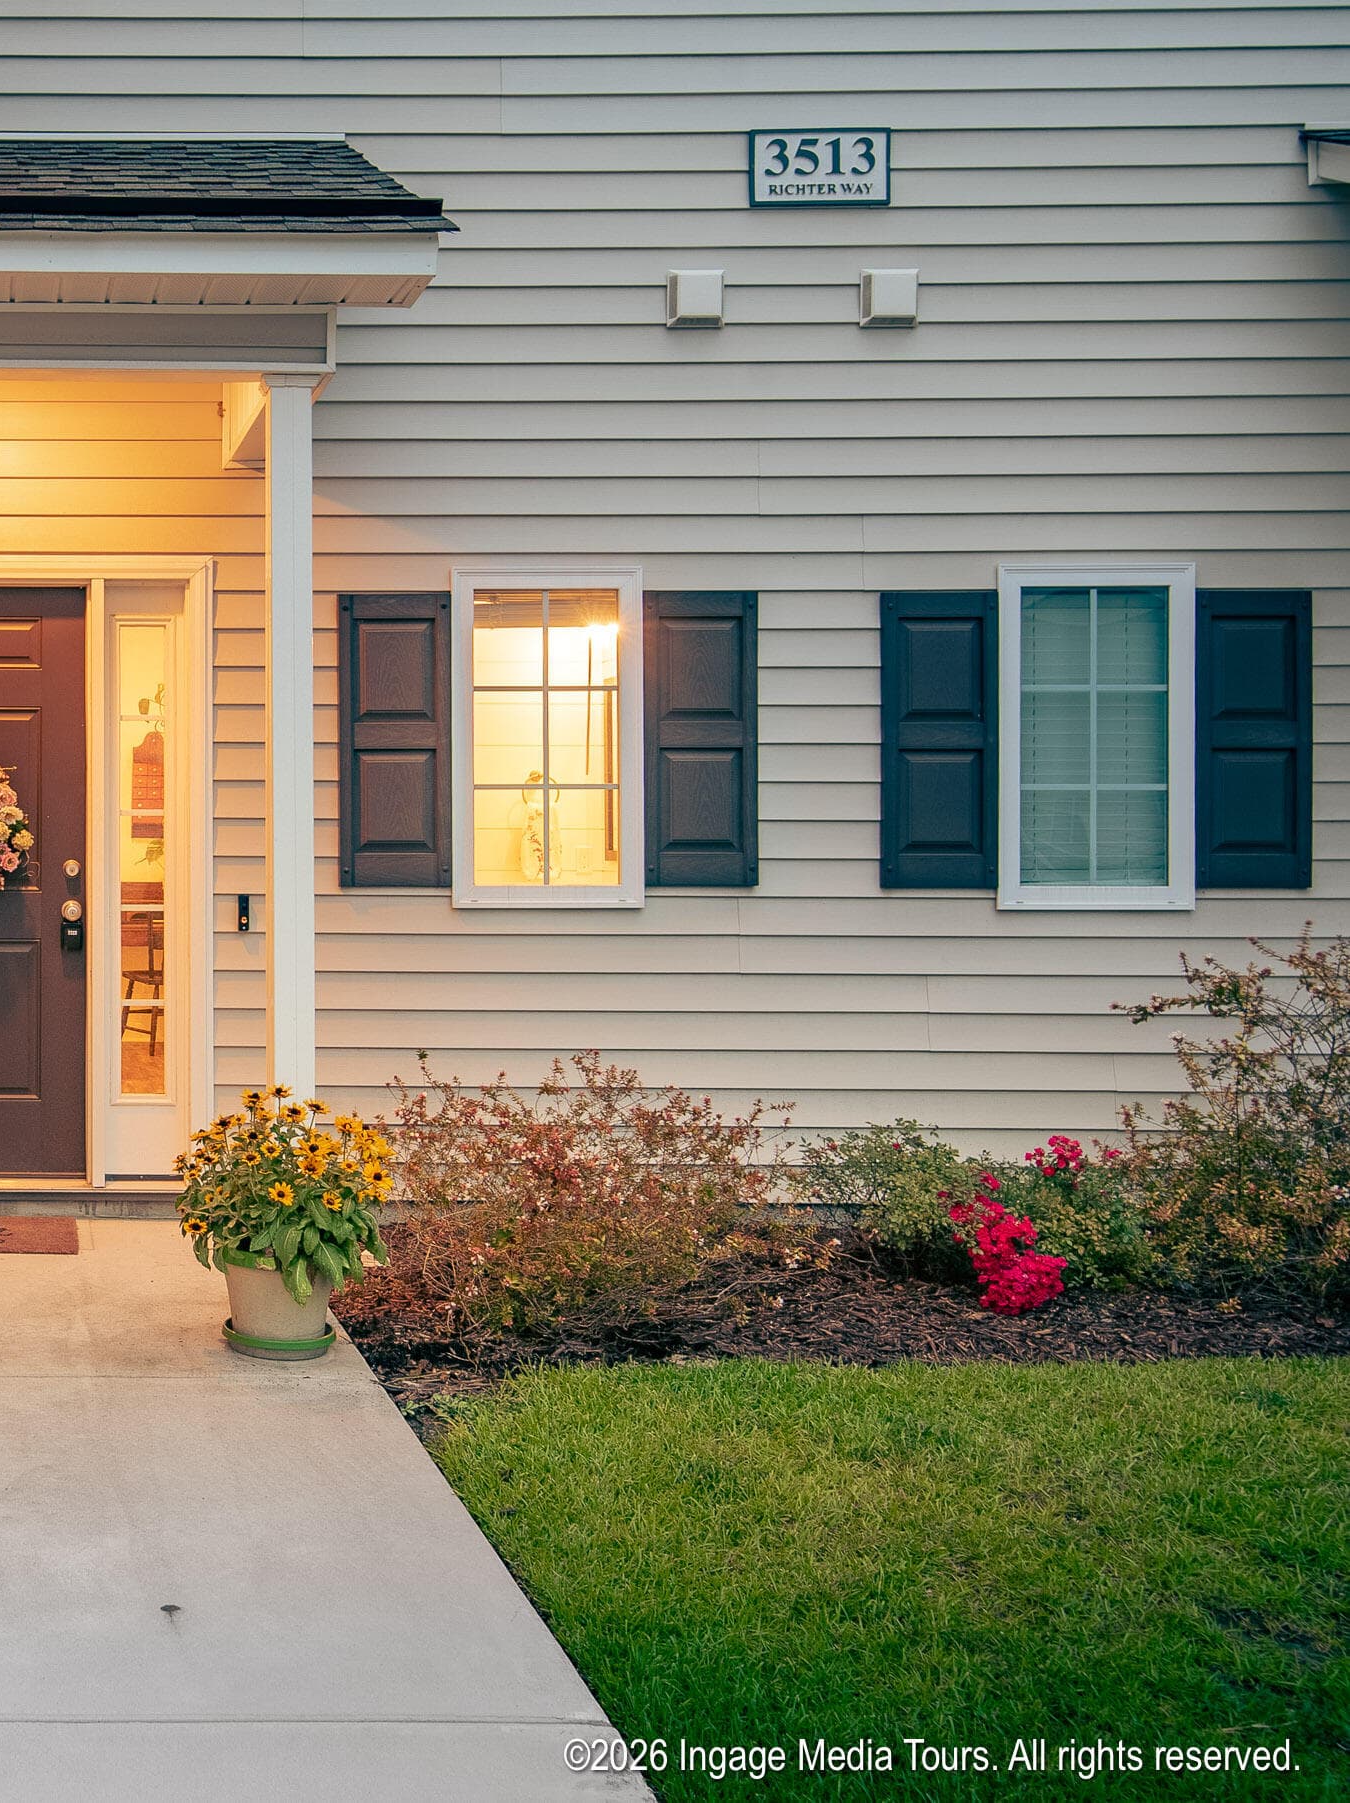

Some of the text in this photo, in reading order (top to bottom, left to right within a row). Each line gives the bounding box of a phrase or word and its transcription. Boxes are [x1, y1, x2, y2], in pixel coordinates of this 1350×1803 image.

[764, 137, 876, 176] 3513
[768, 182, 874, 196] RICHTER WAY
